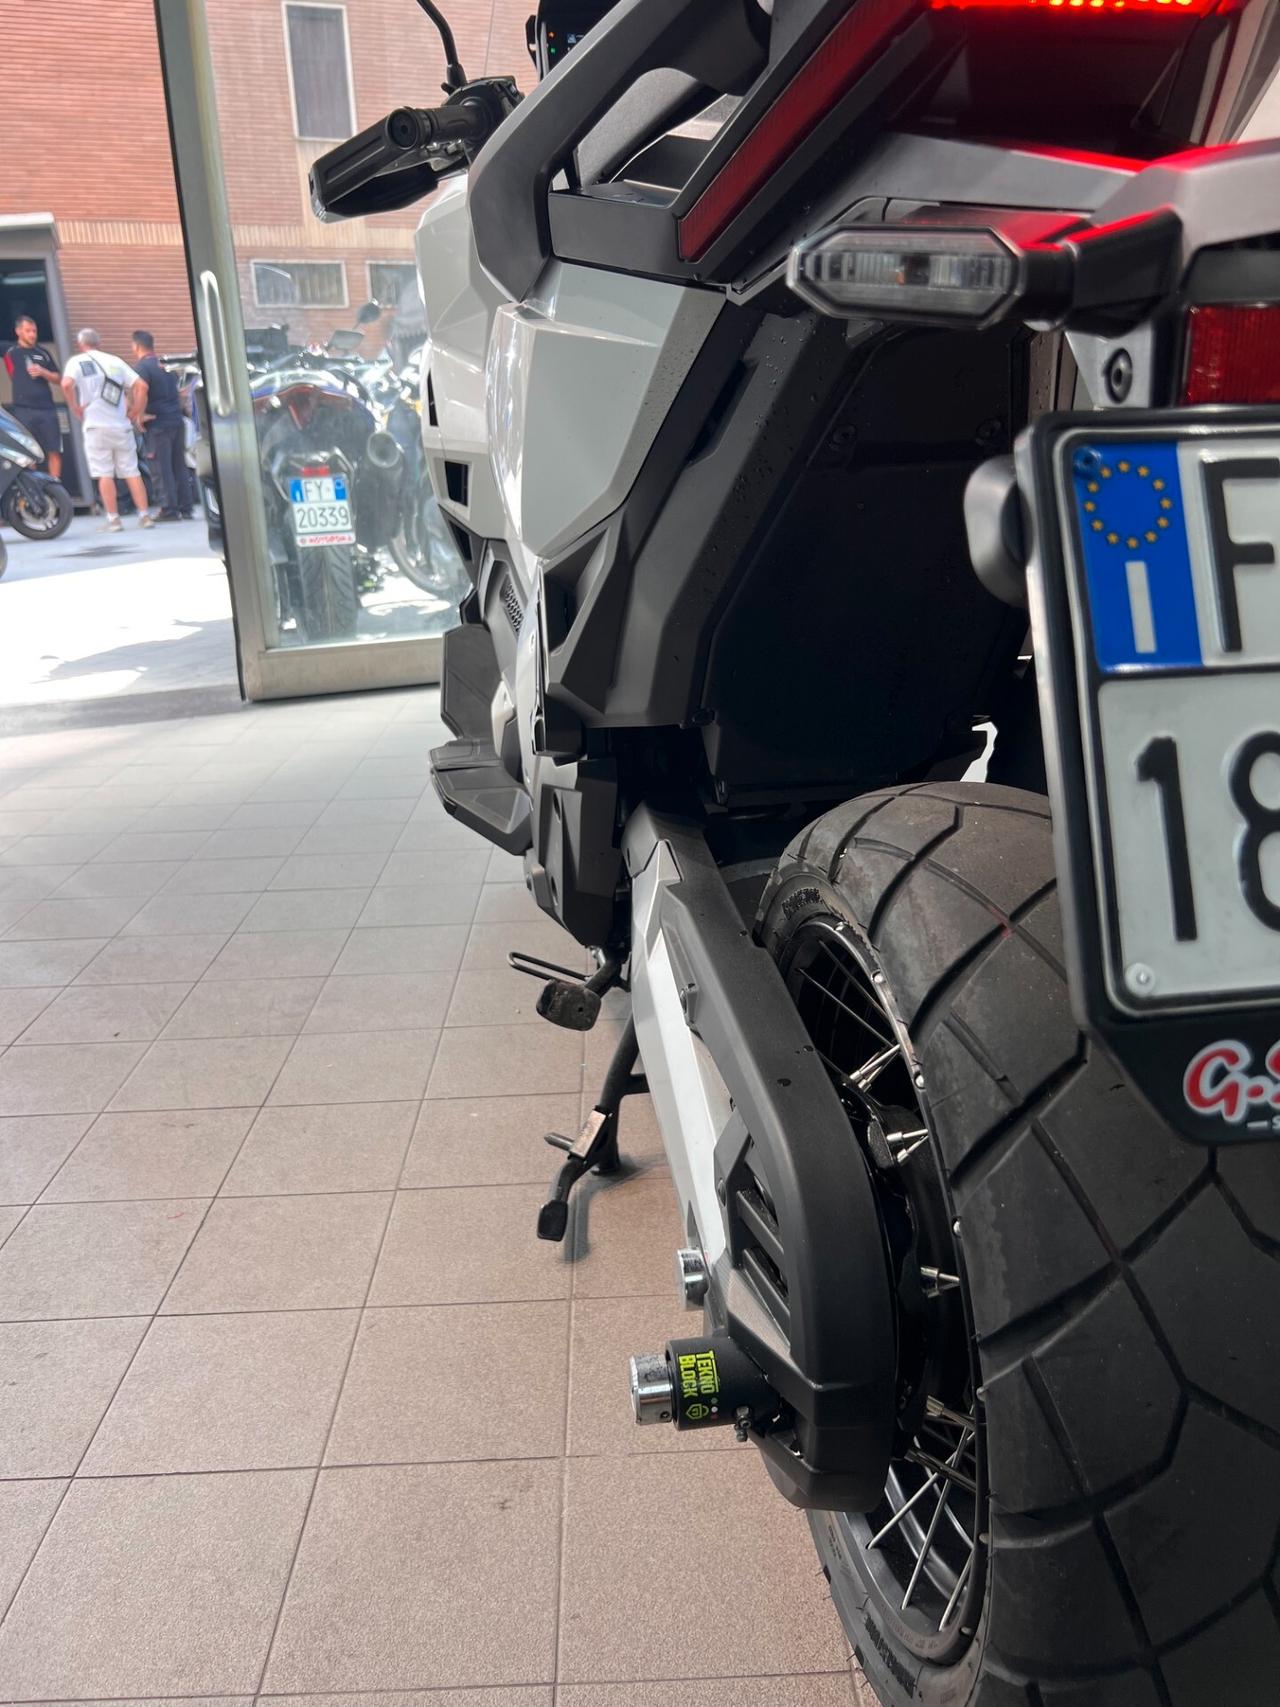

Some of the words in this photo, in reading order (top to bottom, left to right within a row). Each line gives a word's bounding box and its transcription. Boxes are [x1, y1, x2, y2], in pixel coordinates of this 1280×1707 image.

[303, 480, 323, 502] FY
[297, 506, 349, 528] 20339
[1125, 560, 1157, 653] I
[678, 1354, 698, 1398] BLOCK
[696, 1350, 719, 1394] TEKNO
